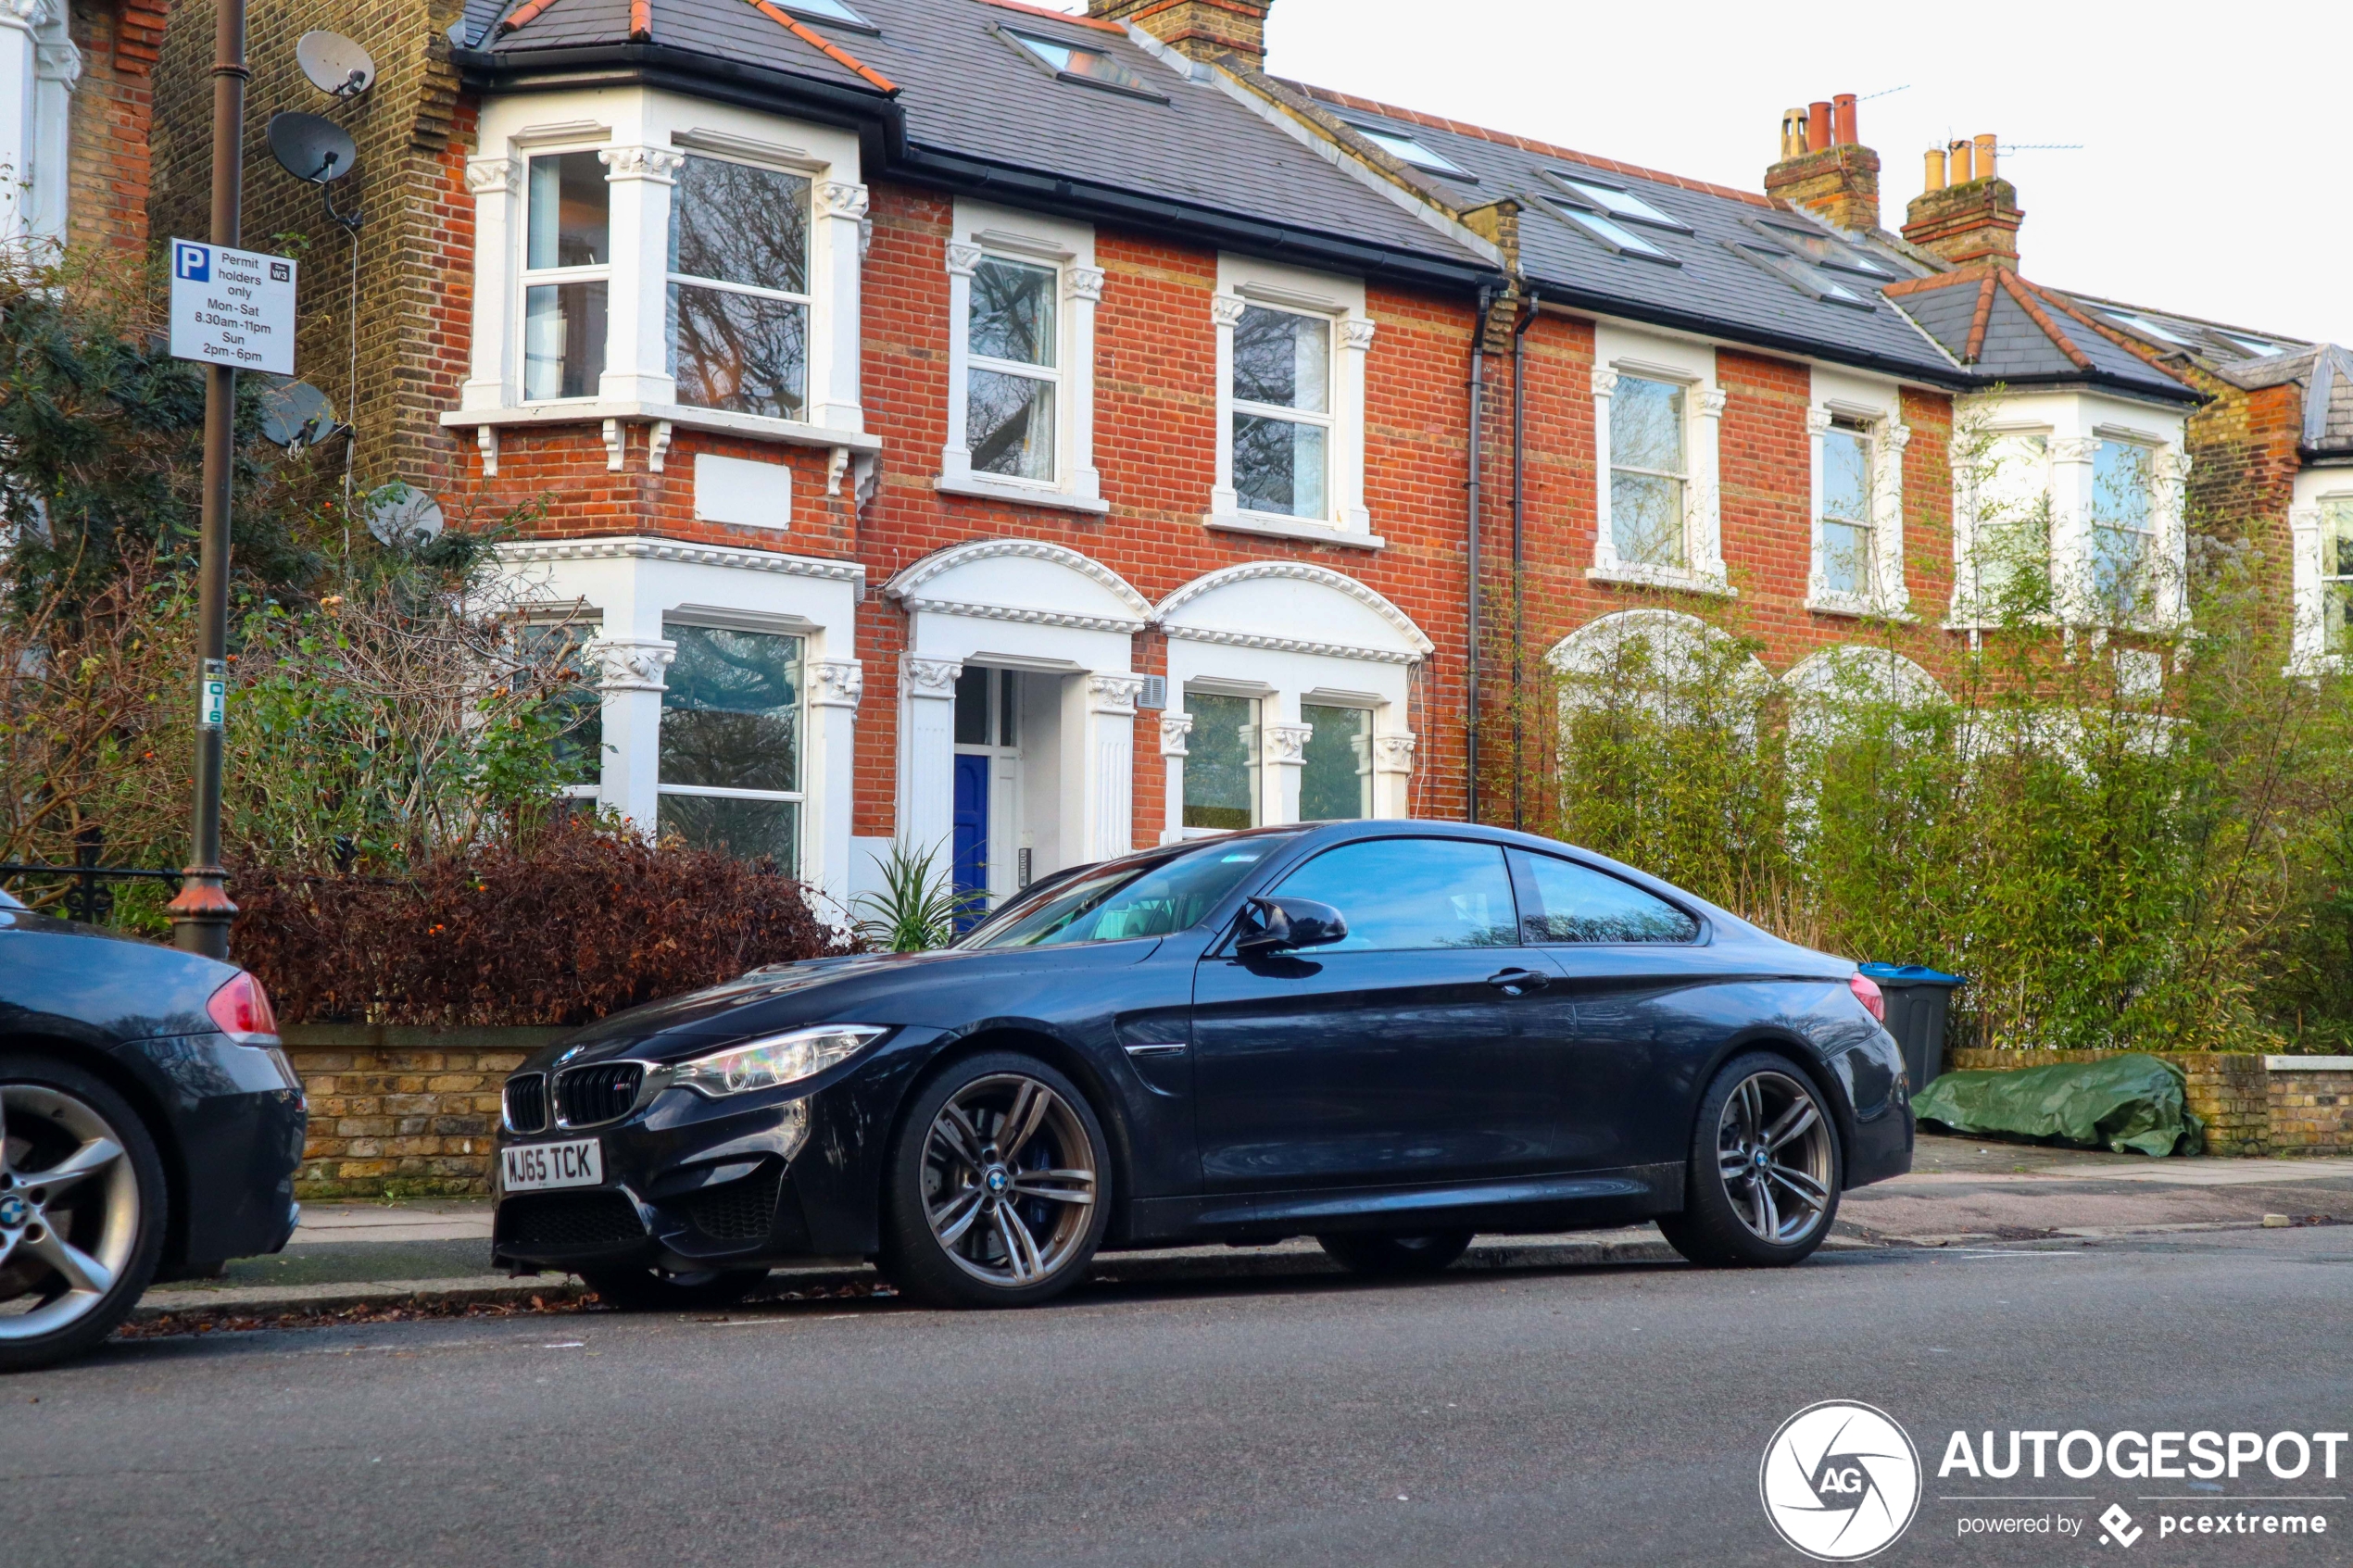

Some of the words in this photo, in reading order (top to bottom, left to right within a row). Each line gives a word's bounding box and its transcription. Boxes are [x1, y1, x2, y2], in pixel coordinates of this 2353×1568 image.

[182, 246, 205, 278] P
[221, 253, 259, 270] Permit
[219, 269, 262, 285] holders
[272, 270, 287, 280] W3
[227, 286, 252, 300] only
[222, 332, 245, 345] Sun
[508, 1149, 547, 1183] MJ65
[550, 1144, 591, 1180] TCK
